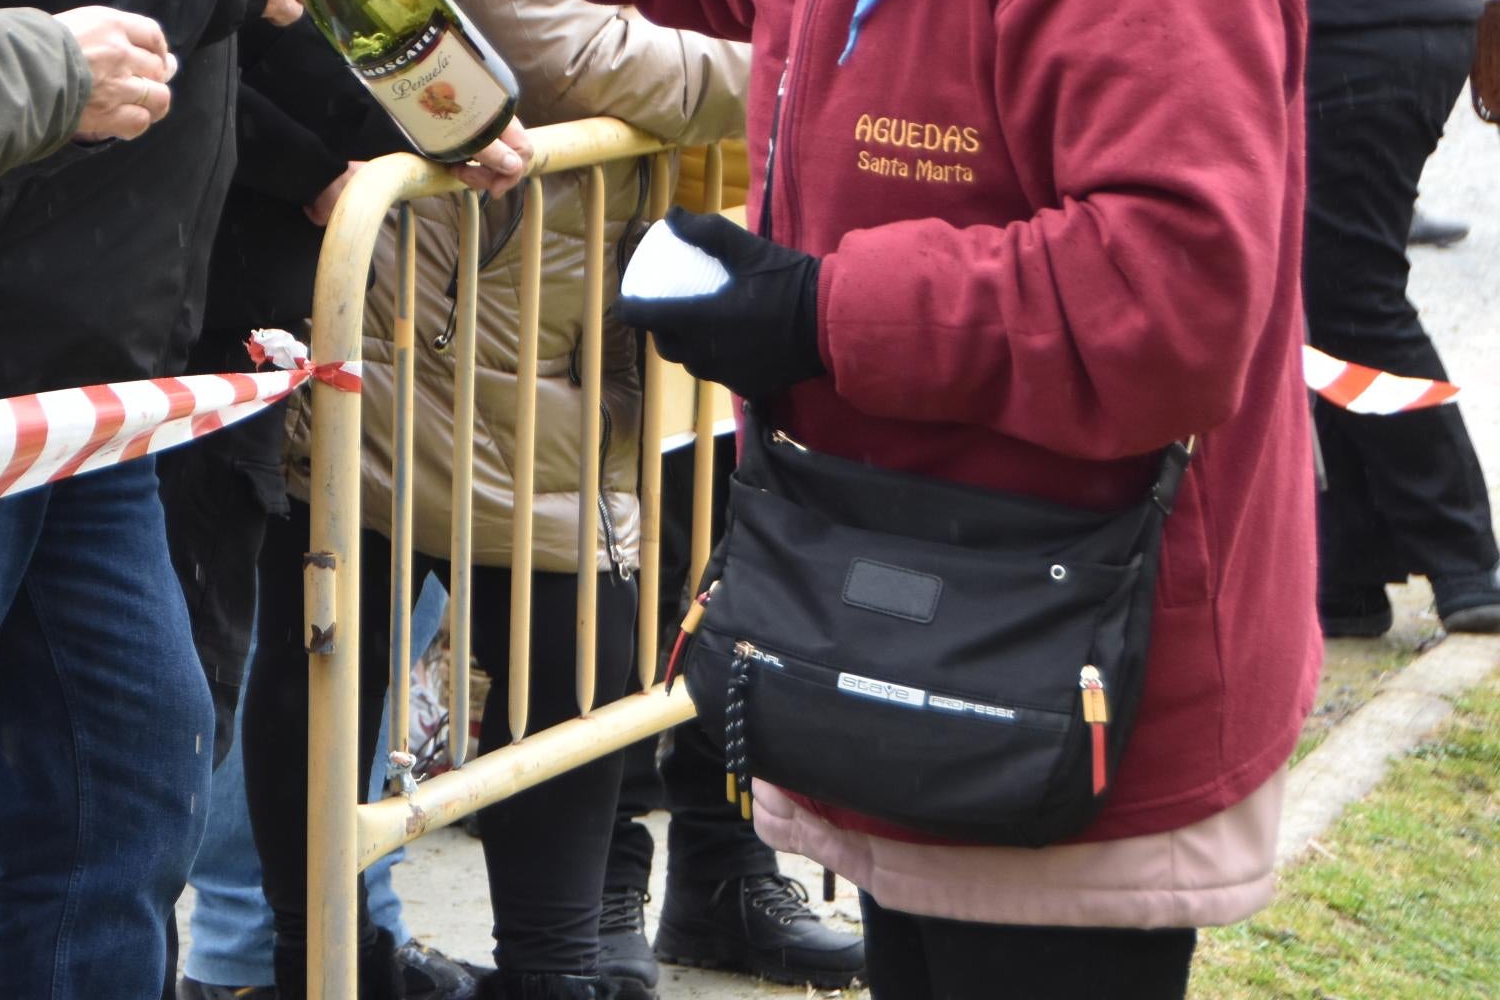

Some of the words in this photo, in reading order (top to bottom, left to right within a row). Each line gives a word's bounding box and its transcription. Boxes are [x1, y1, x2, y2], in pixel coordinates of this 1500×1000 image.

[362, 26, 439, 77] MOSCATEL
[855, 114, 980, 153] AGUEDAS
[857, 150, 908, 177] Santa
[915, 159, 973, 182] Marta
